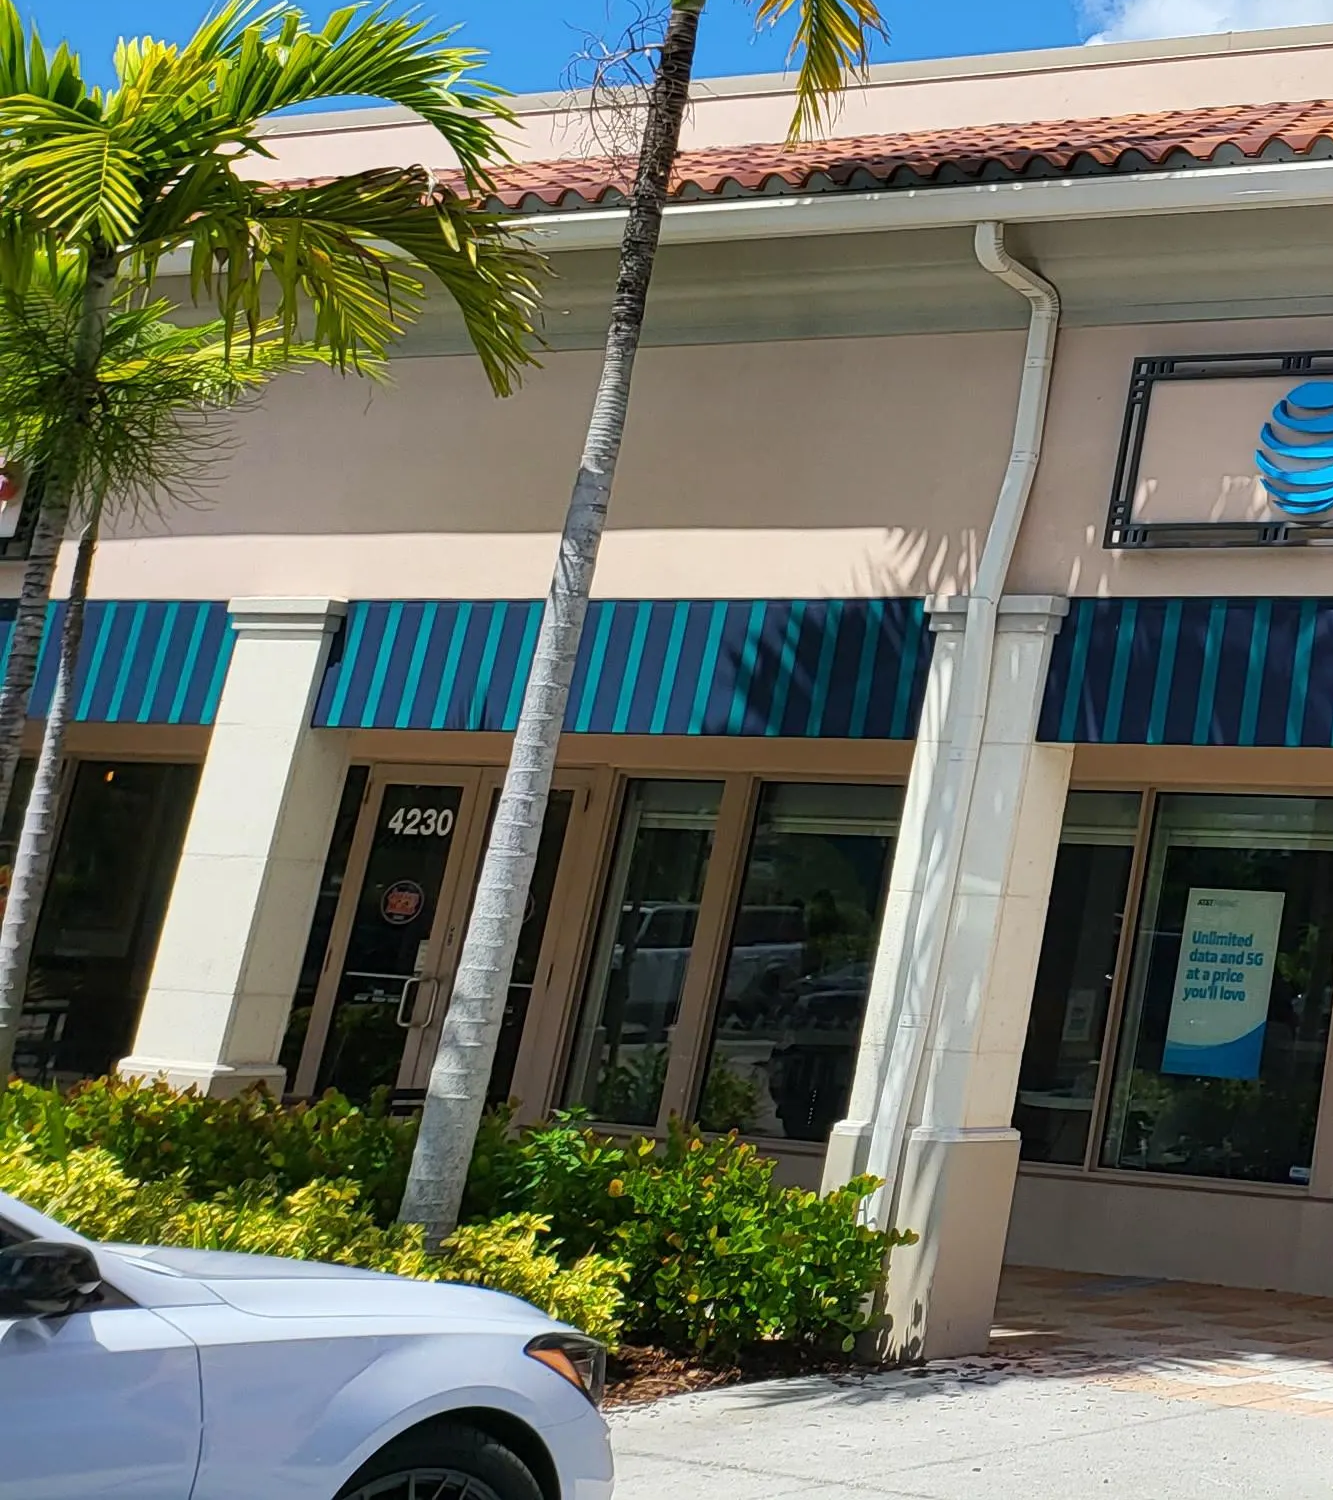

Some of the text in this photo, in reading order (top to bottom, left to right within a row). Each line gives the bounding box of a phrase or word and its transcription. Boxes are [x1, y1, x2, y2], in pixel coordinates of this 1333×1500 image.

[388, 808, 454, 836] 4230
[1192, 930, 1253, 947] Unlimited
[1190, 948, 1264, 966] data and 5G
[1186, 968, 1244, 986] at a price
[1182, 986, 1246, 1002] you'll love
